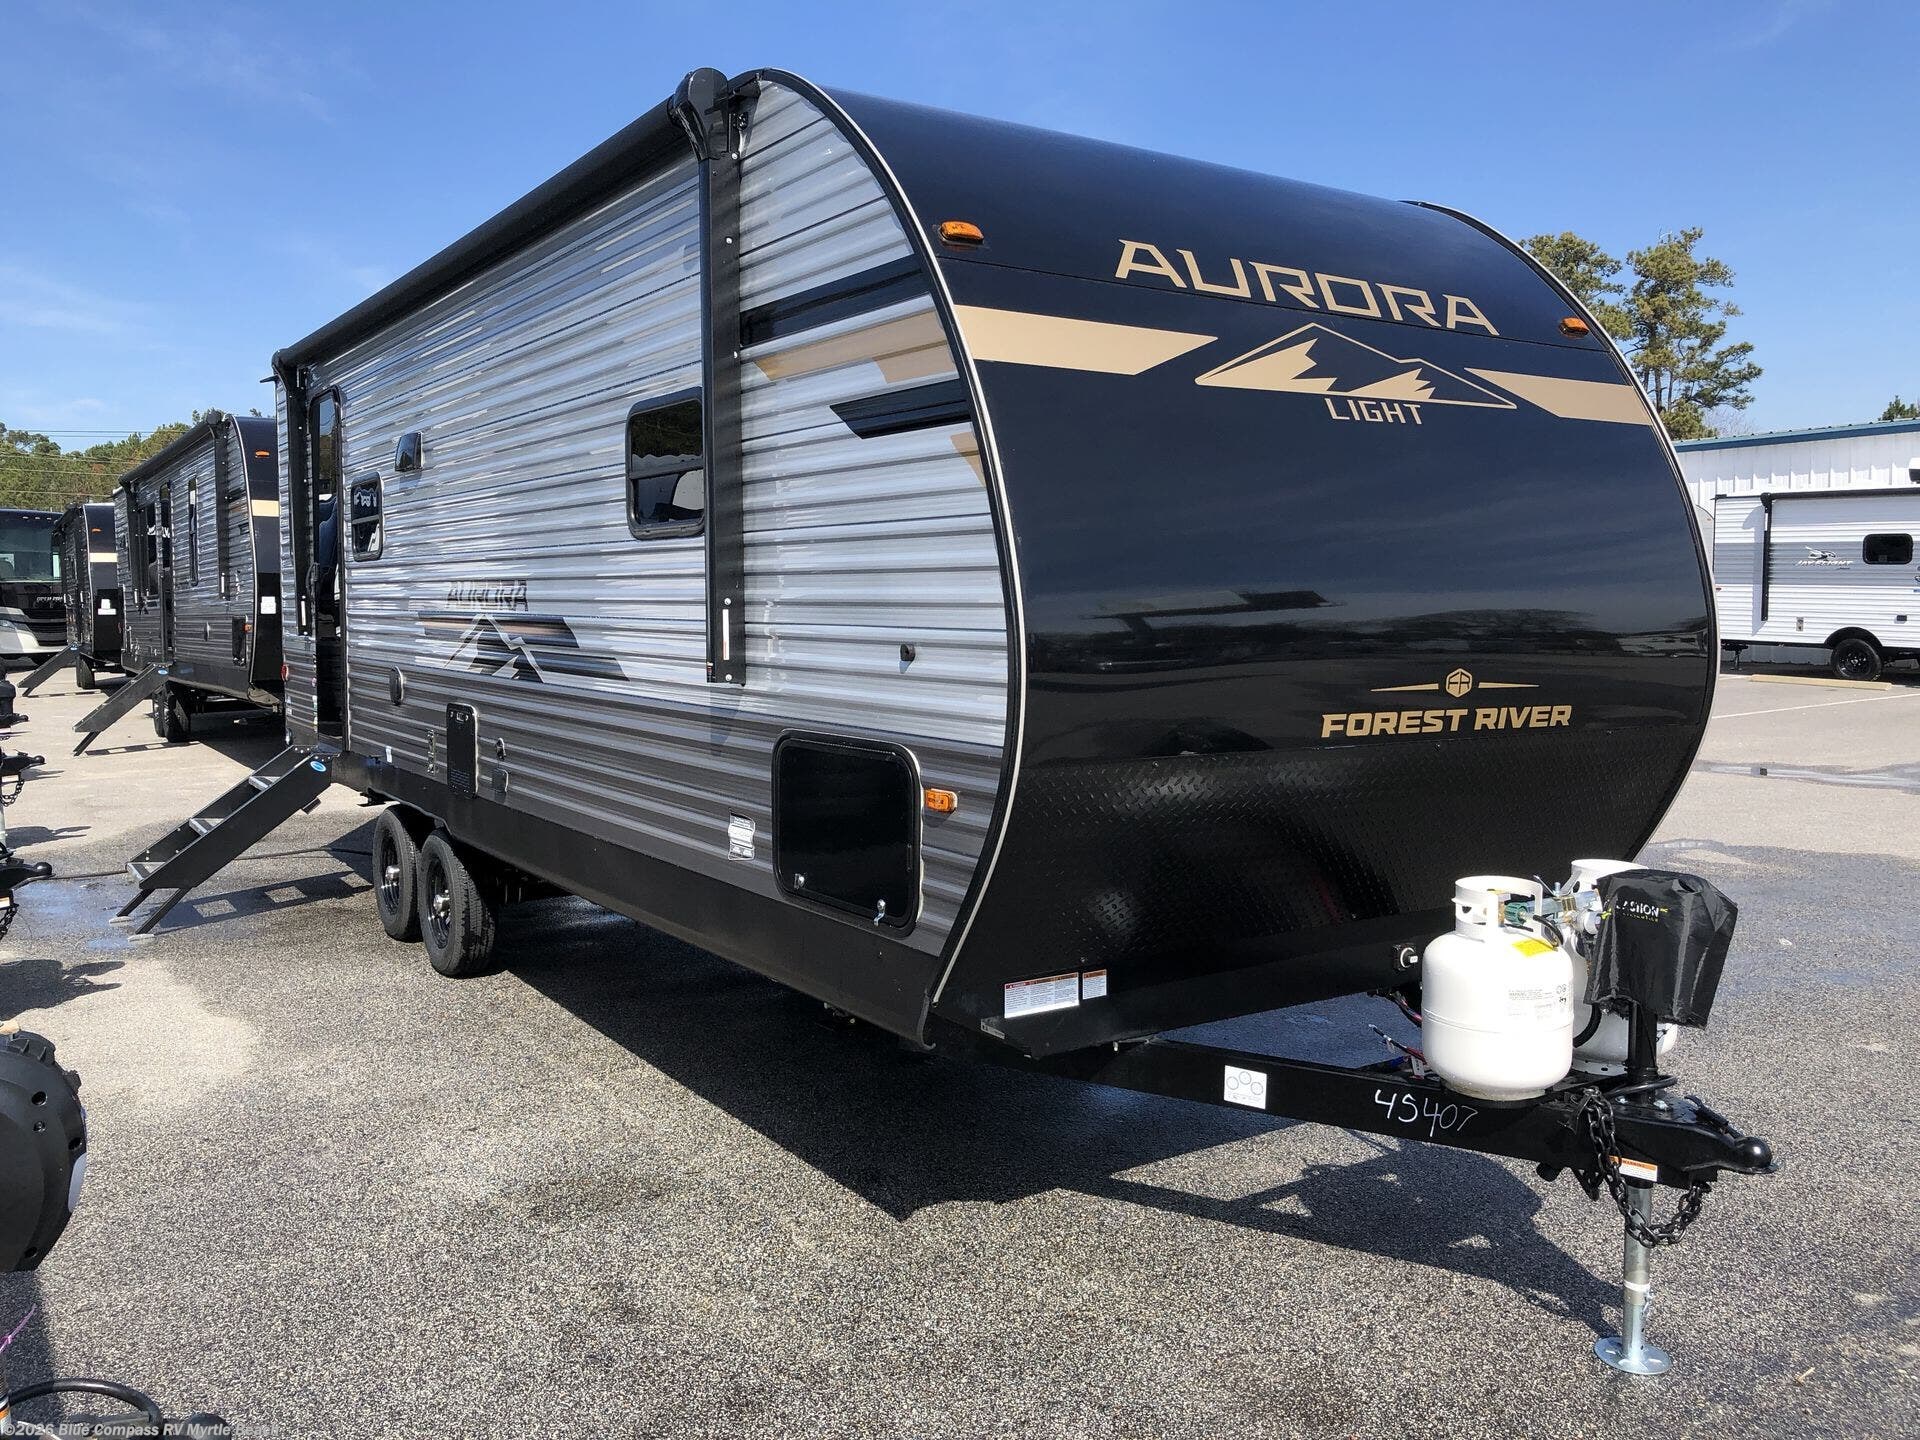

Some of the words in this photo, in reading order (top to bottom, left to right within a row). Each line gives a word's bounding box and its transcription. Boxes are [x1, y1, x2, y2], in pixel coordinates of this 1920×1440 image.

[1115, 239, 1500, 336] AURORA
[1324, 397, 1424, 425] LIGHT
[1321, 708, 1468, 738] FOREST
[1473, 705, 1573, 731] RIVER
